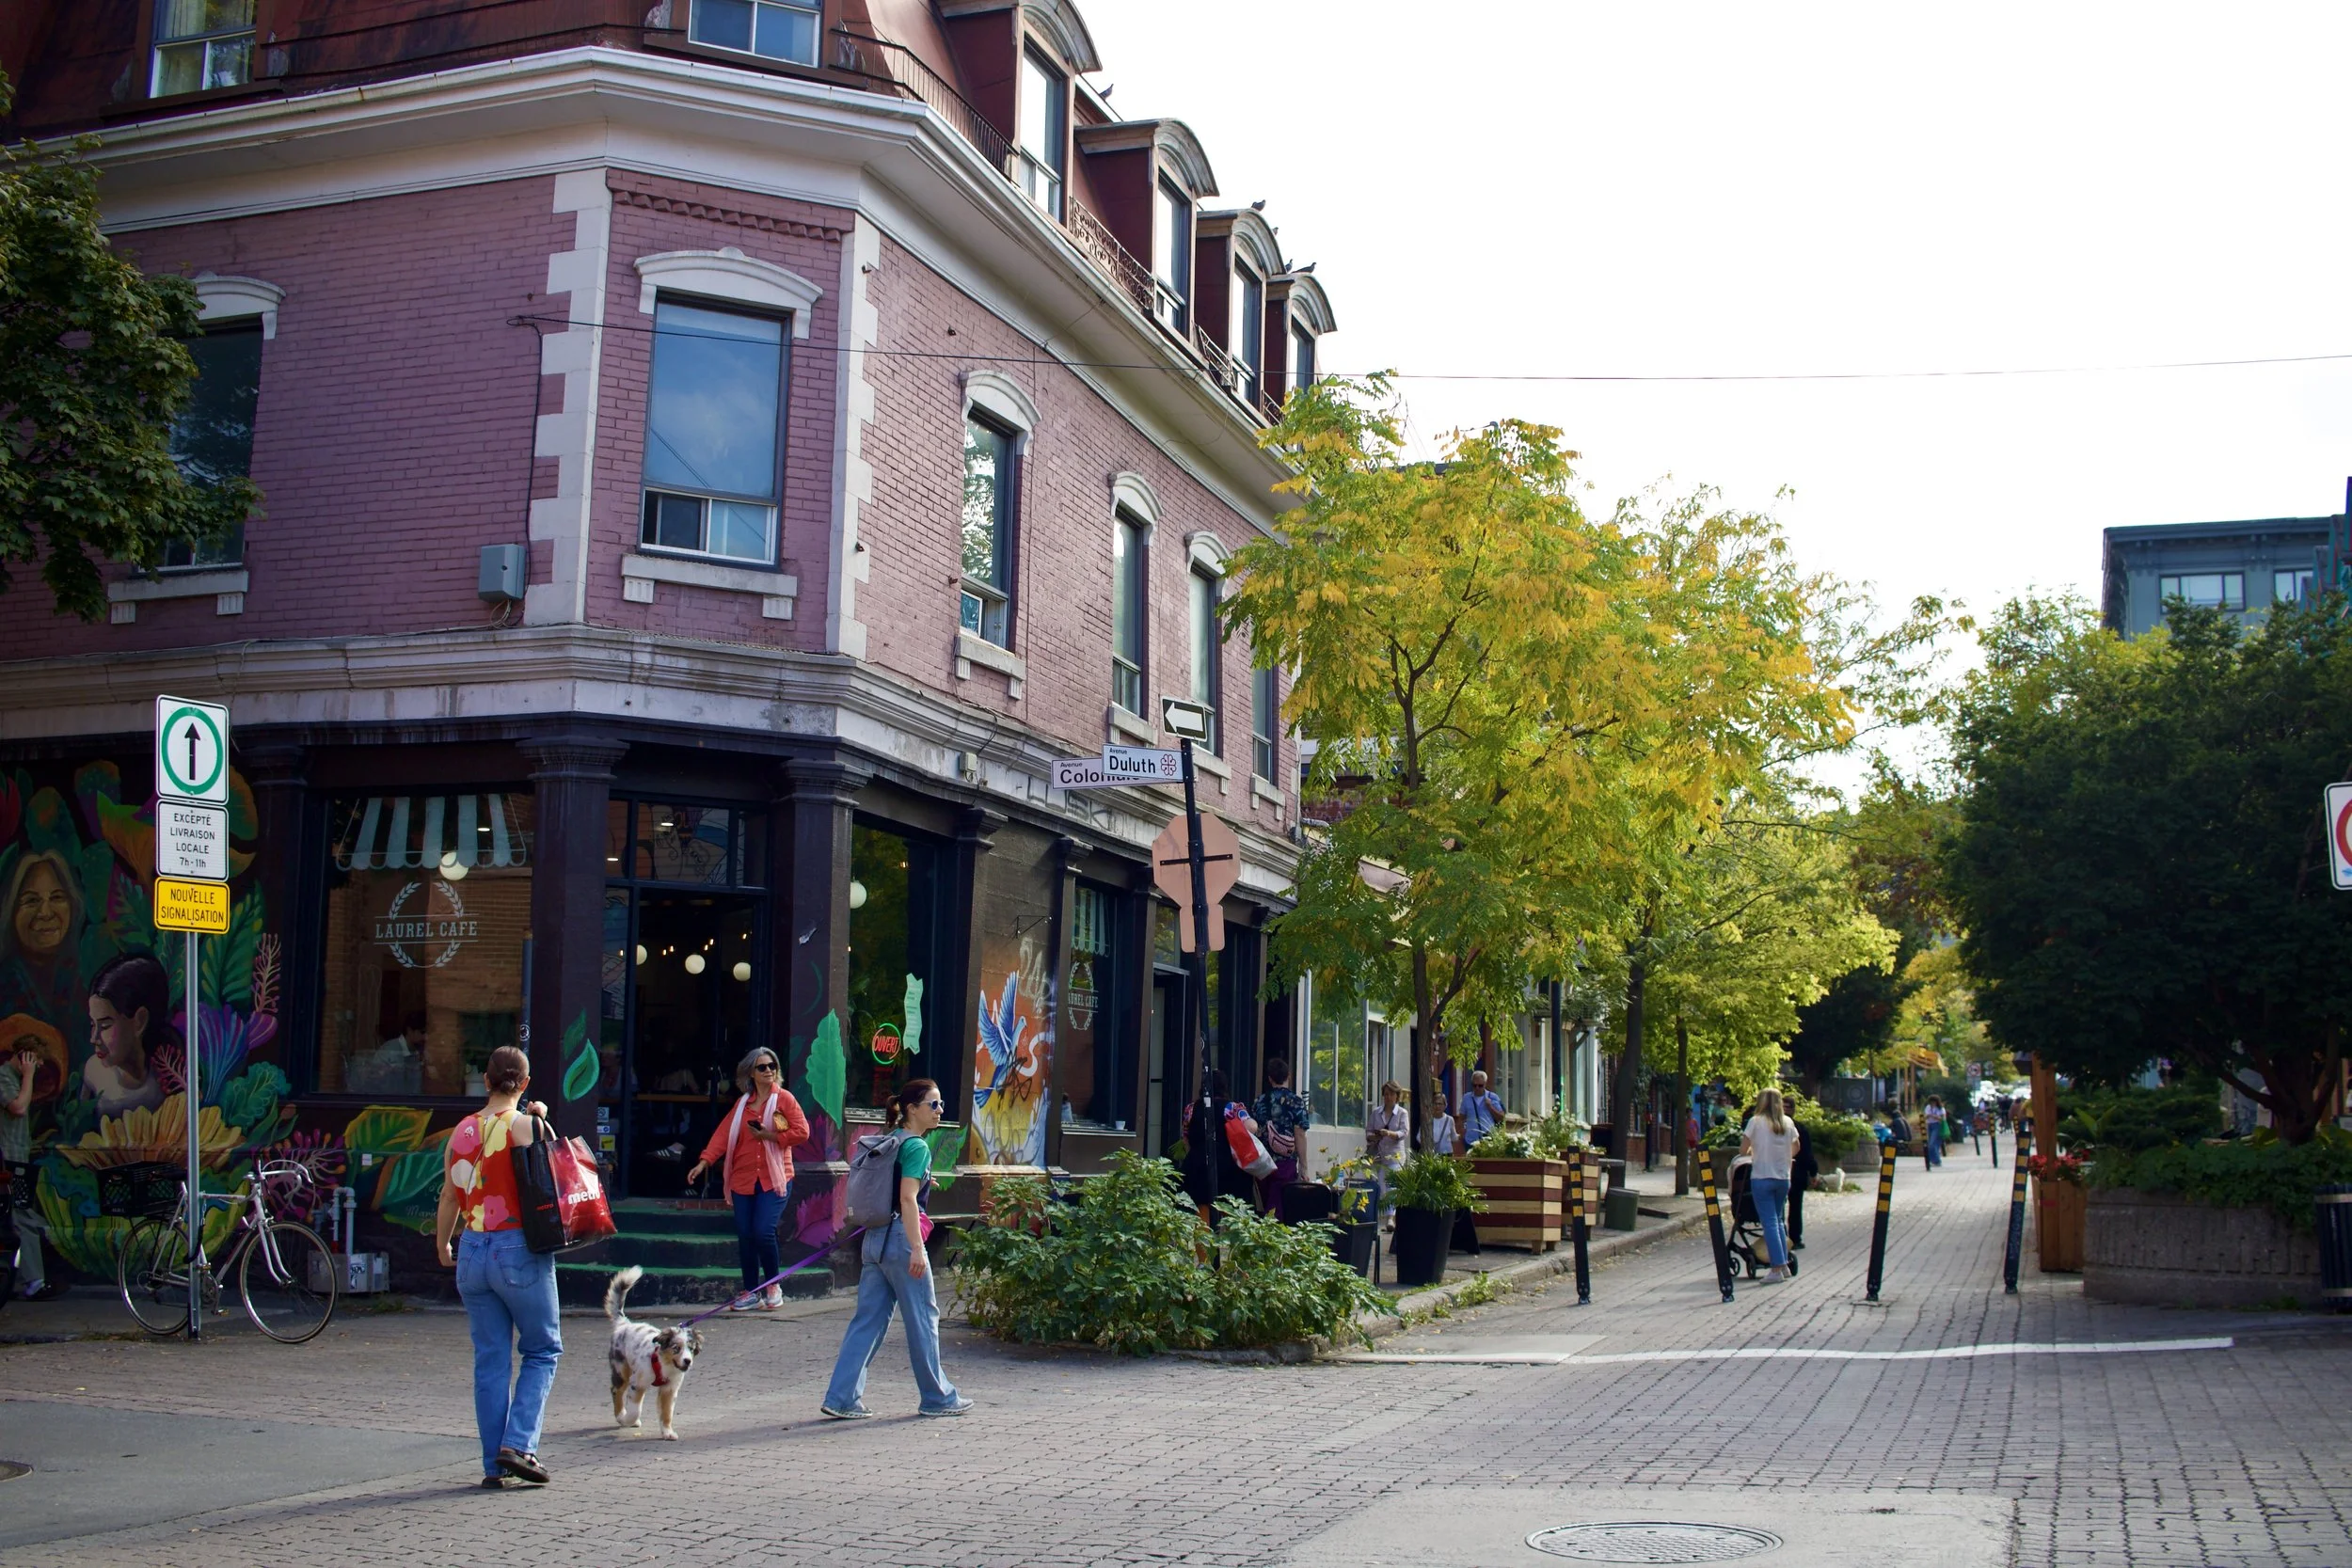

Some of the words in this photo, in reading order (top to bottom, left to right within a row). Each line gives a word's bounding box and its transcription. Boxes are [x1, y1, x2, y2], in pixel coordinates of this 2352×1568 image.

[1109, 755, 1156, 774] Duluth
[1060, 768, 1139, 784] Colon
[174, 813, 212, 826] EXCEPTÉ
[170, 828, 215, 840] LIVRAISON
[176, 843, 209, 854] LOCALE
[170, 889, 215, 905] NOUVELLE
[161, 906, 224, 923] SIGNALISATION
[375, 923, 434, 938] LAUREL
[439, 922, 478, 937] CAFE
[873, 1036, 898, 1053] OUVERT
